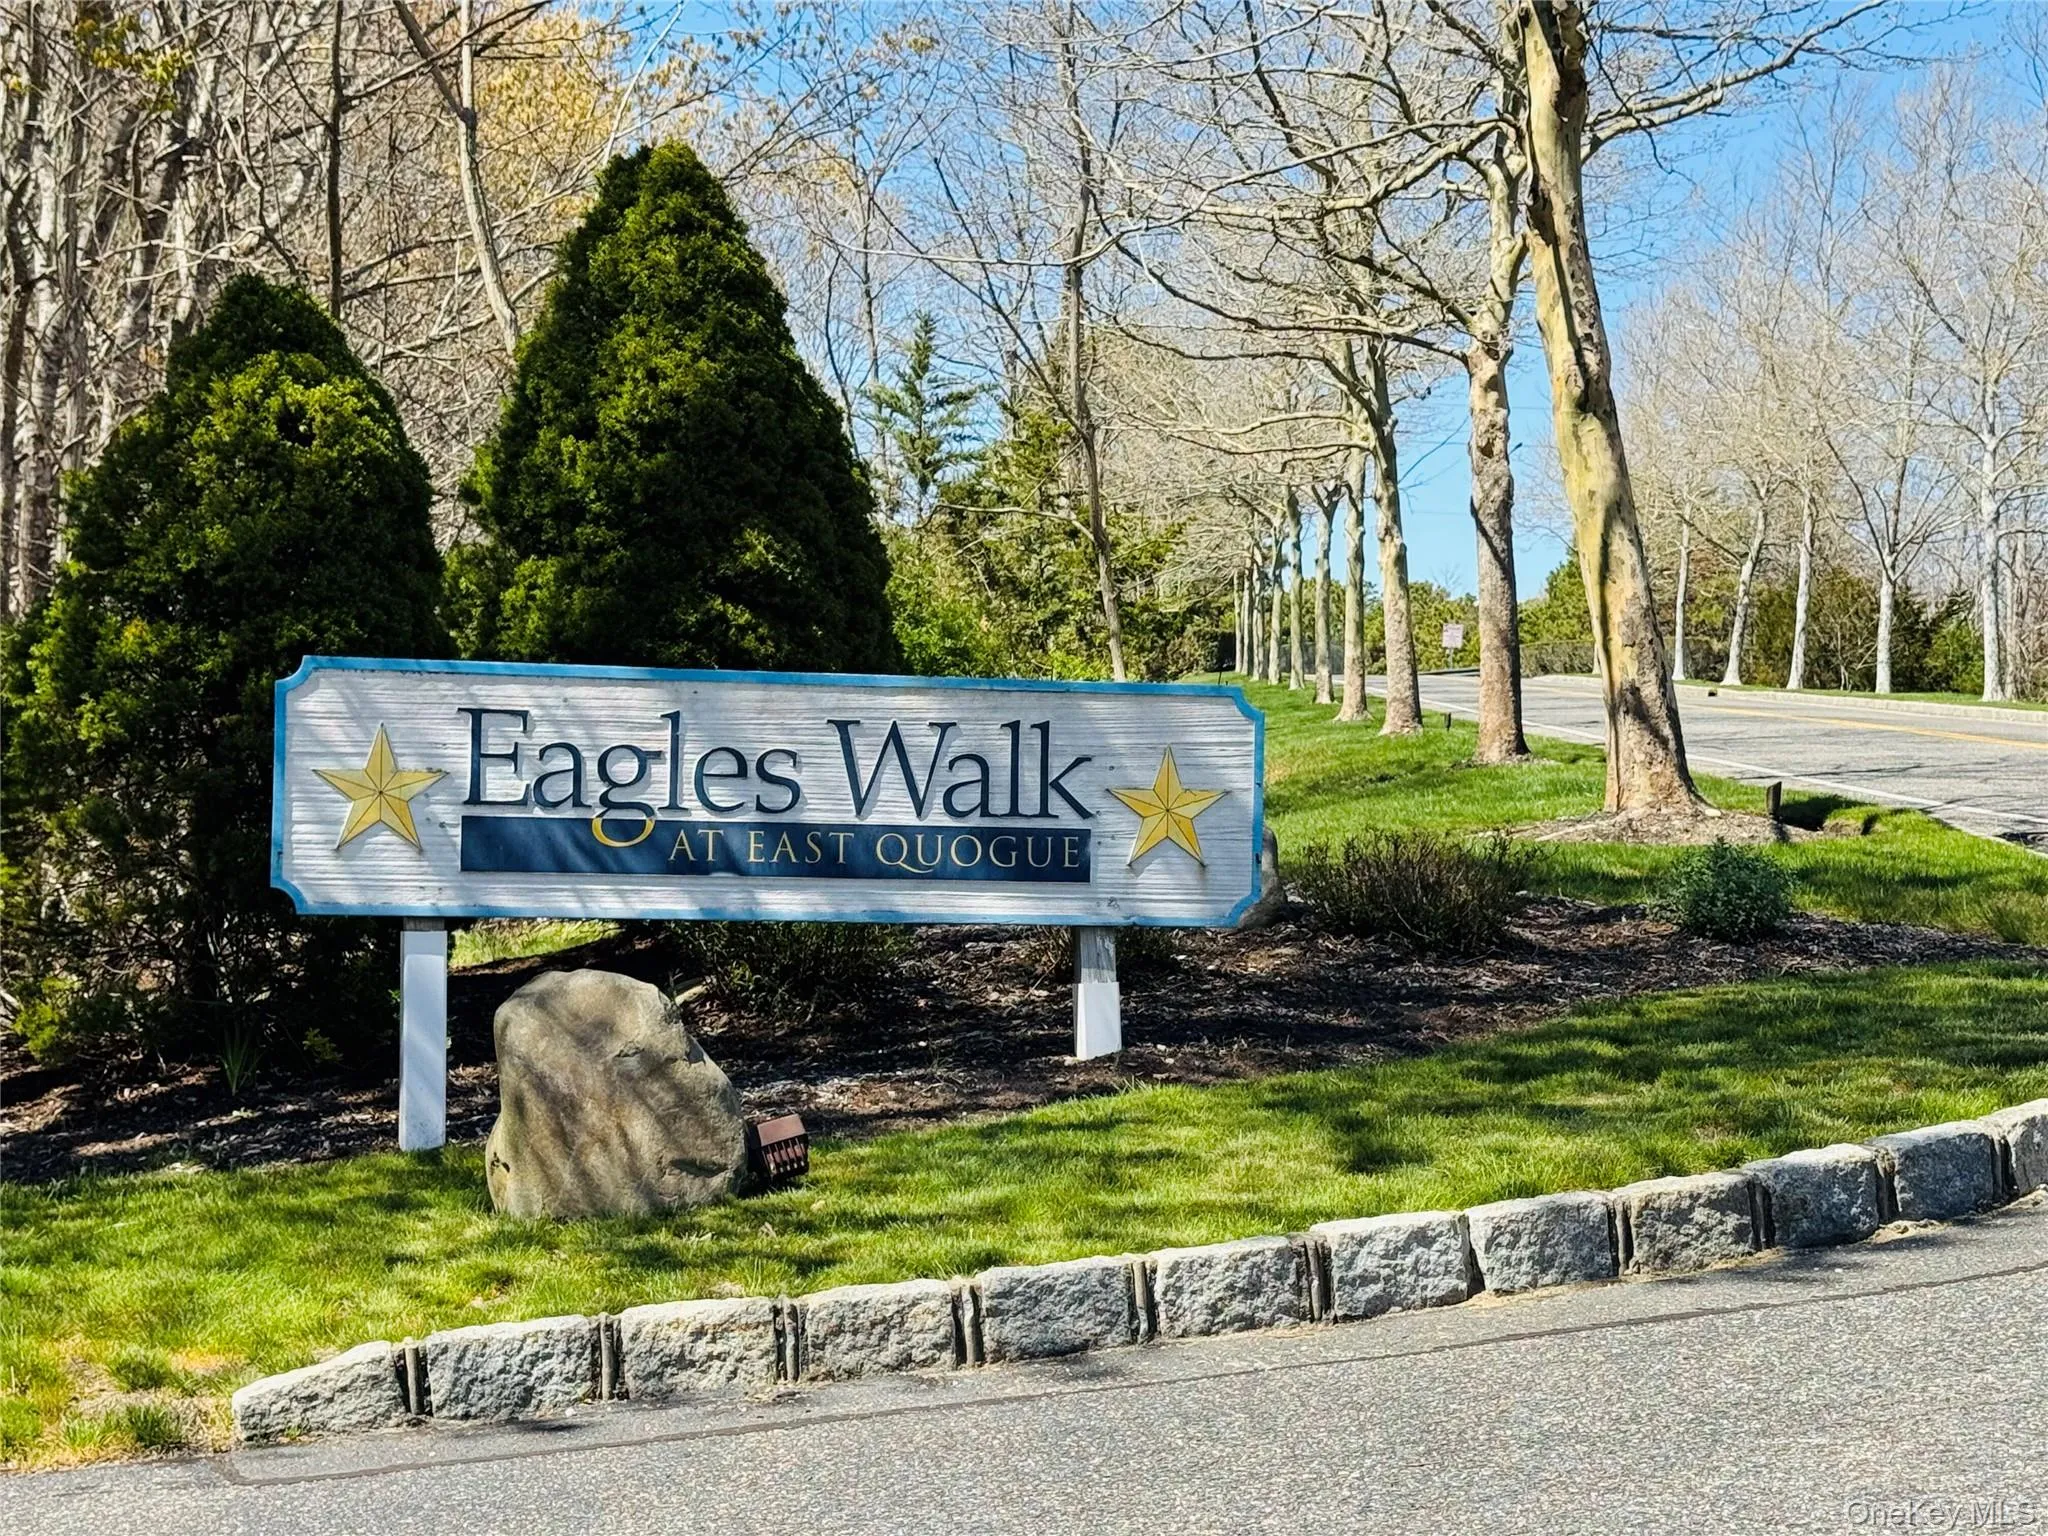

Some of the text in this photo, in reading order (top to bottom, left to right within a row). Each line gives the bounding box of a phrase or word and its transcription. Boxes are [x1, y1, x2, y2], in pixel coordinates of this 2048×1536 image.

[457, 707, 1098, 848] Eagles Walk
[668, 828, 1081, 874] AT EAST QUOGUE
